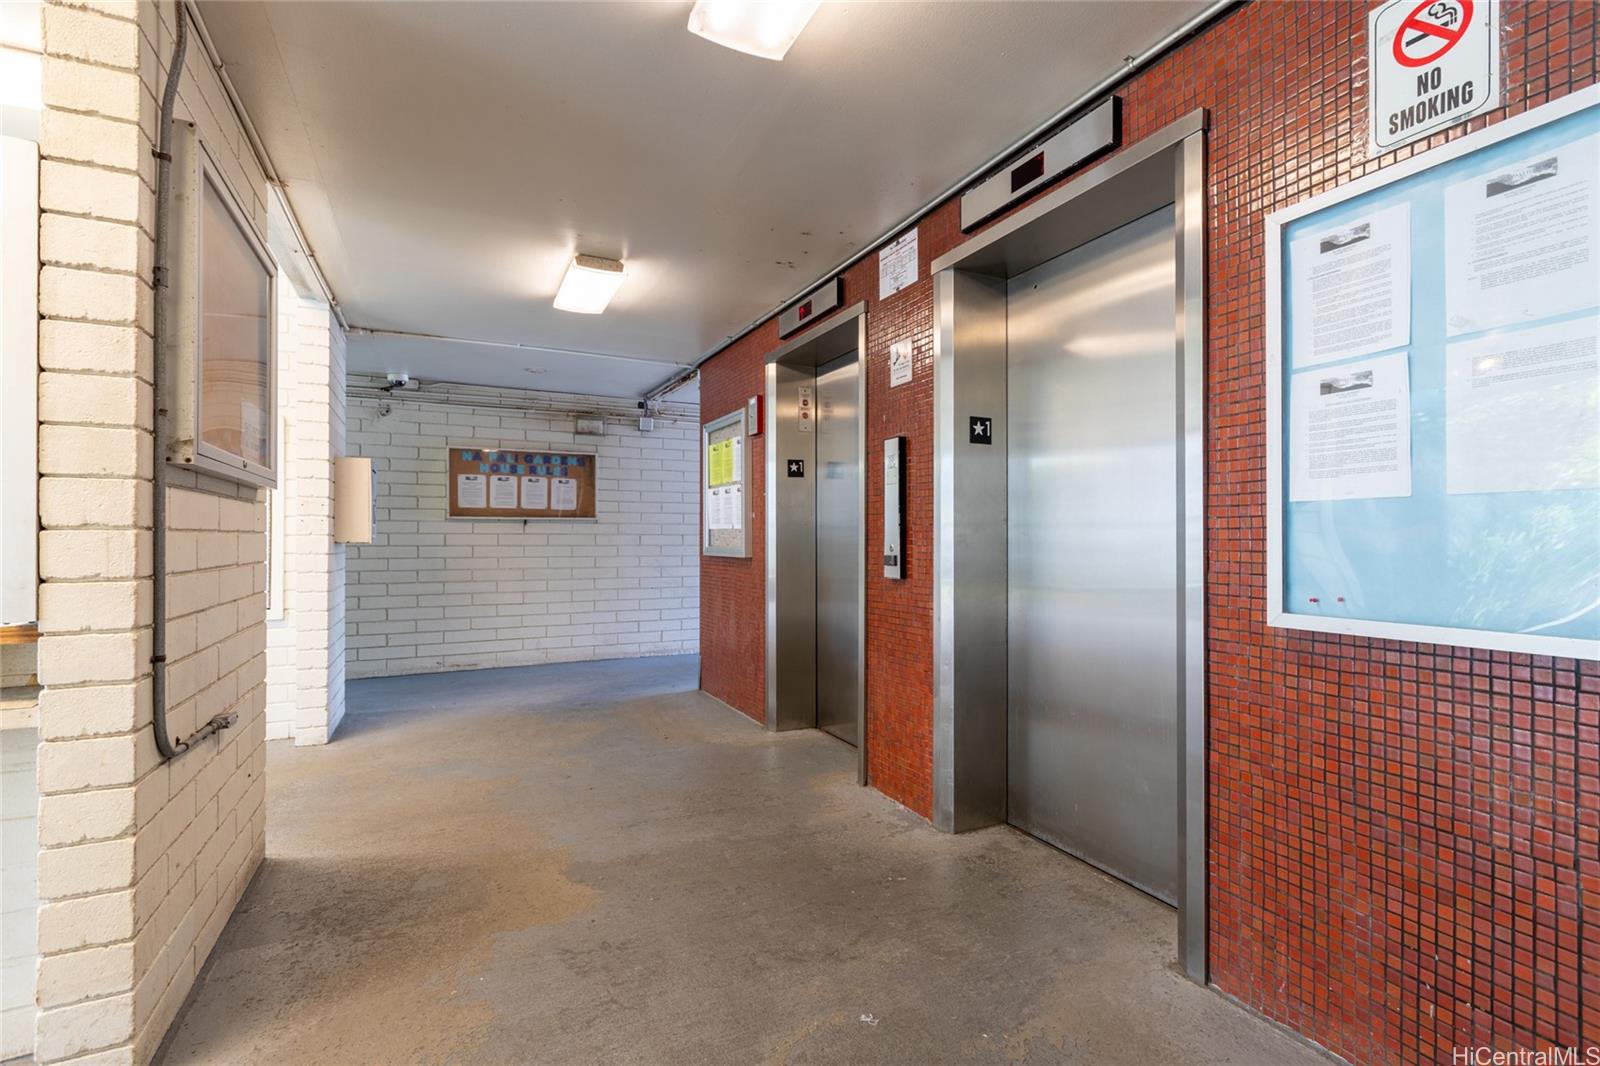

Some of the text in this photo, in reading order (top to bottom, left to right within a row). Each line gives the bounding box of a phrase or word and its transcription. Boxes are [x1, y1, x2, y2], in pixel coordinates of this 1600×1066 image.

[1416, 66, 1442, 97] NO
[1388, 80, 1474, 136] SMOKING
[462, 450, 586, 466] NA PALI GARDENS
[480, 463, 568, 476] HOUSE RULES
